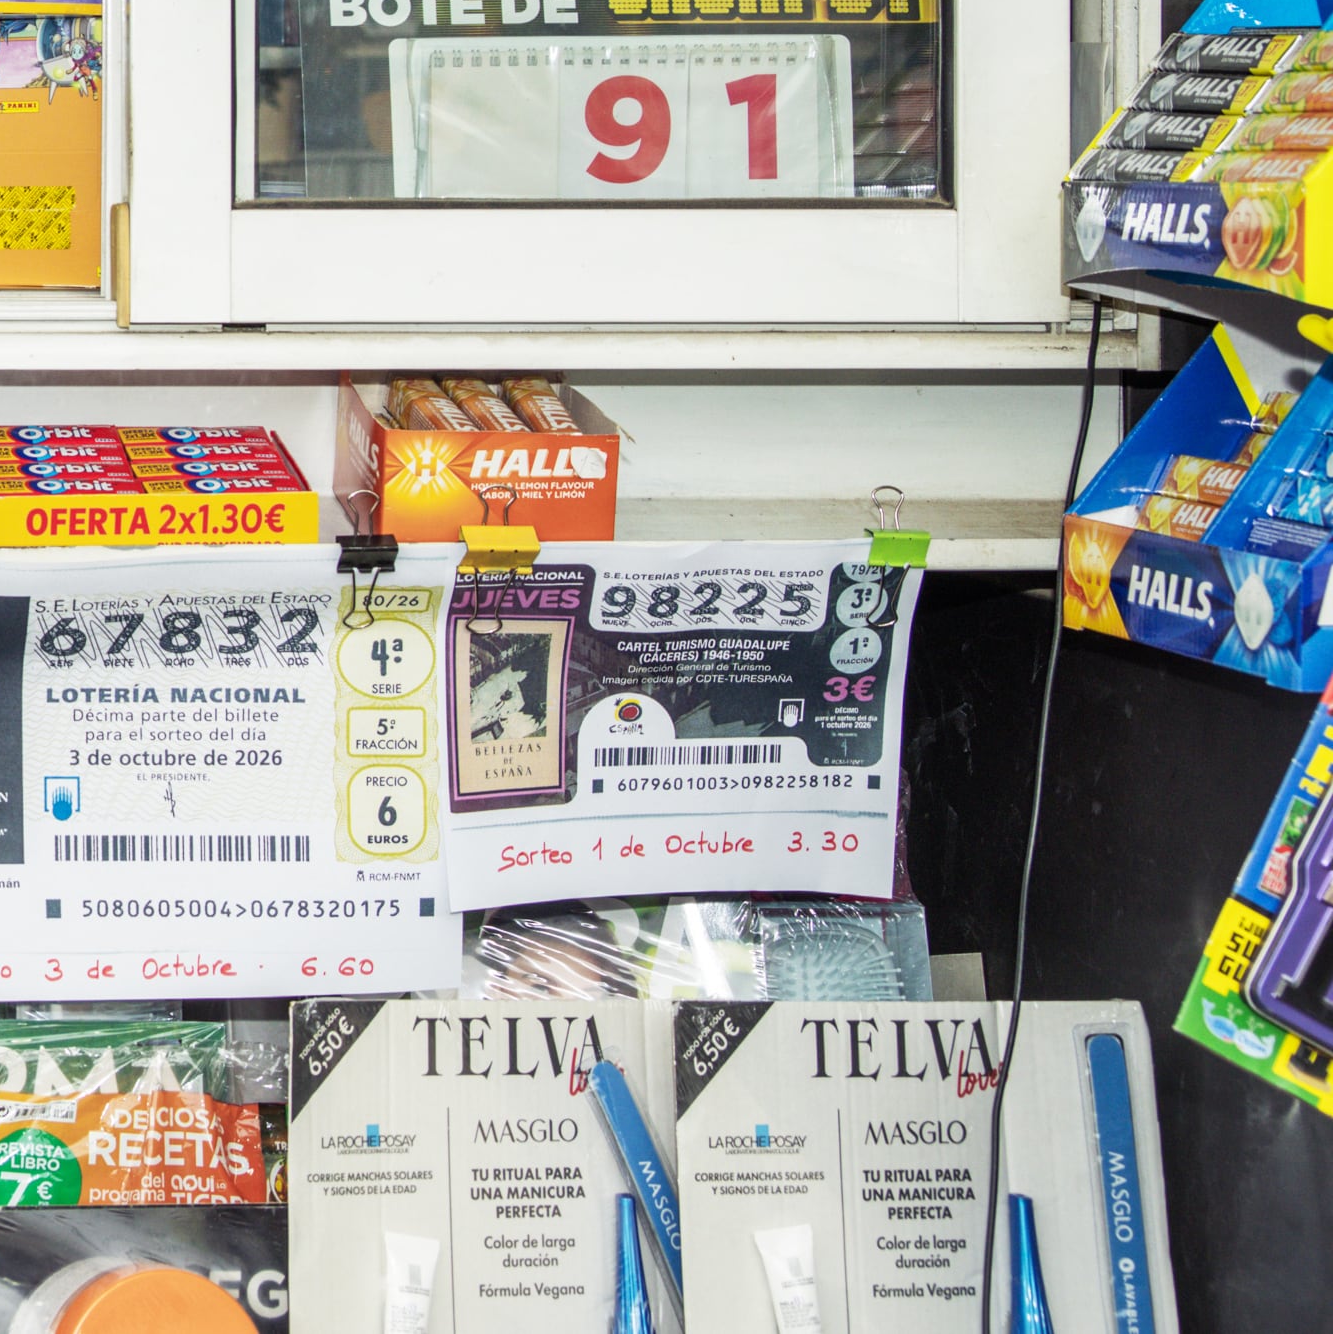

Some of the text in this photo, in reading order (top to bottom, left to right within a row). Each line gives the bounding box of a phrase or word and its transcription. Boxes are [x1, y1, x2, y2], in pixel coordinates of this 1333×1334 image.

[584, 73, 778, 184] 9 1
[515, 481, 594, 491] LEMON FLAVOUR
[823, 676, 876, 702] 3€
[498, 846, 572, 872] Sorteo
[620, 836, 645, 856] de
[666, 835, 754, 855] Octubre
[44, 957, 63, 981] 3
[87, 955, 115, 978] de
[141, 956, 237, 978] Octubre
[801, 1017, 994, 1080] TELVA
[473, 1119, 578, 1144] MASGLO
[472, 1168, 582, 1181] TU RITUAL PARA
[694, 1171, 825, 1182] CORRIGE MANCHAS SOLARES
[471, 1186, 586, 1200] UNA MANICURA
[496, 1205, 561, 1218] PERFECTA
[484, 1236, 575, 1252] Color de larga
[503, 1253, 558, 1267] duración
[479, 1283, 585, 1298] Fórmula Vegana
